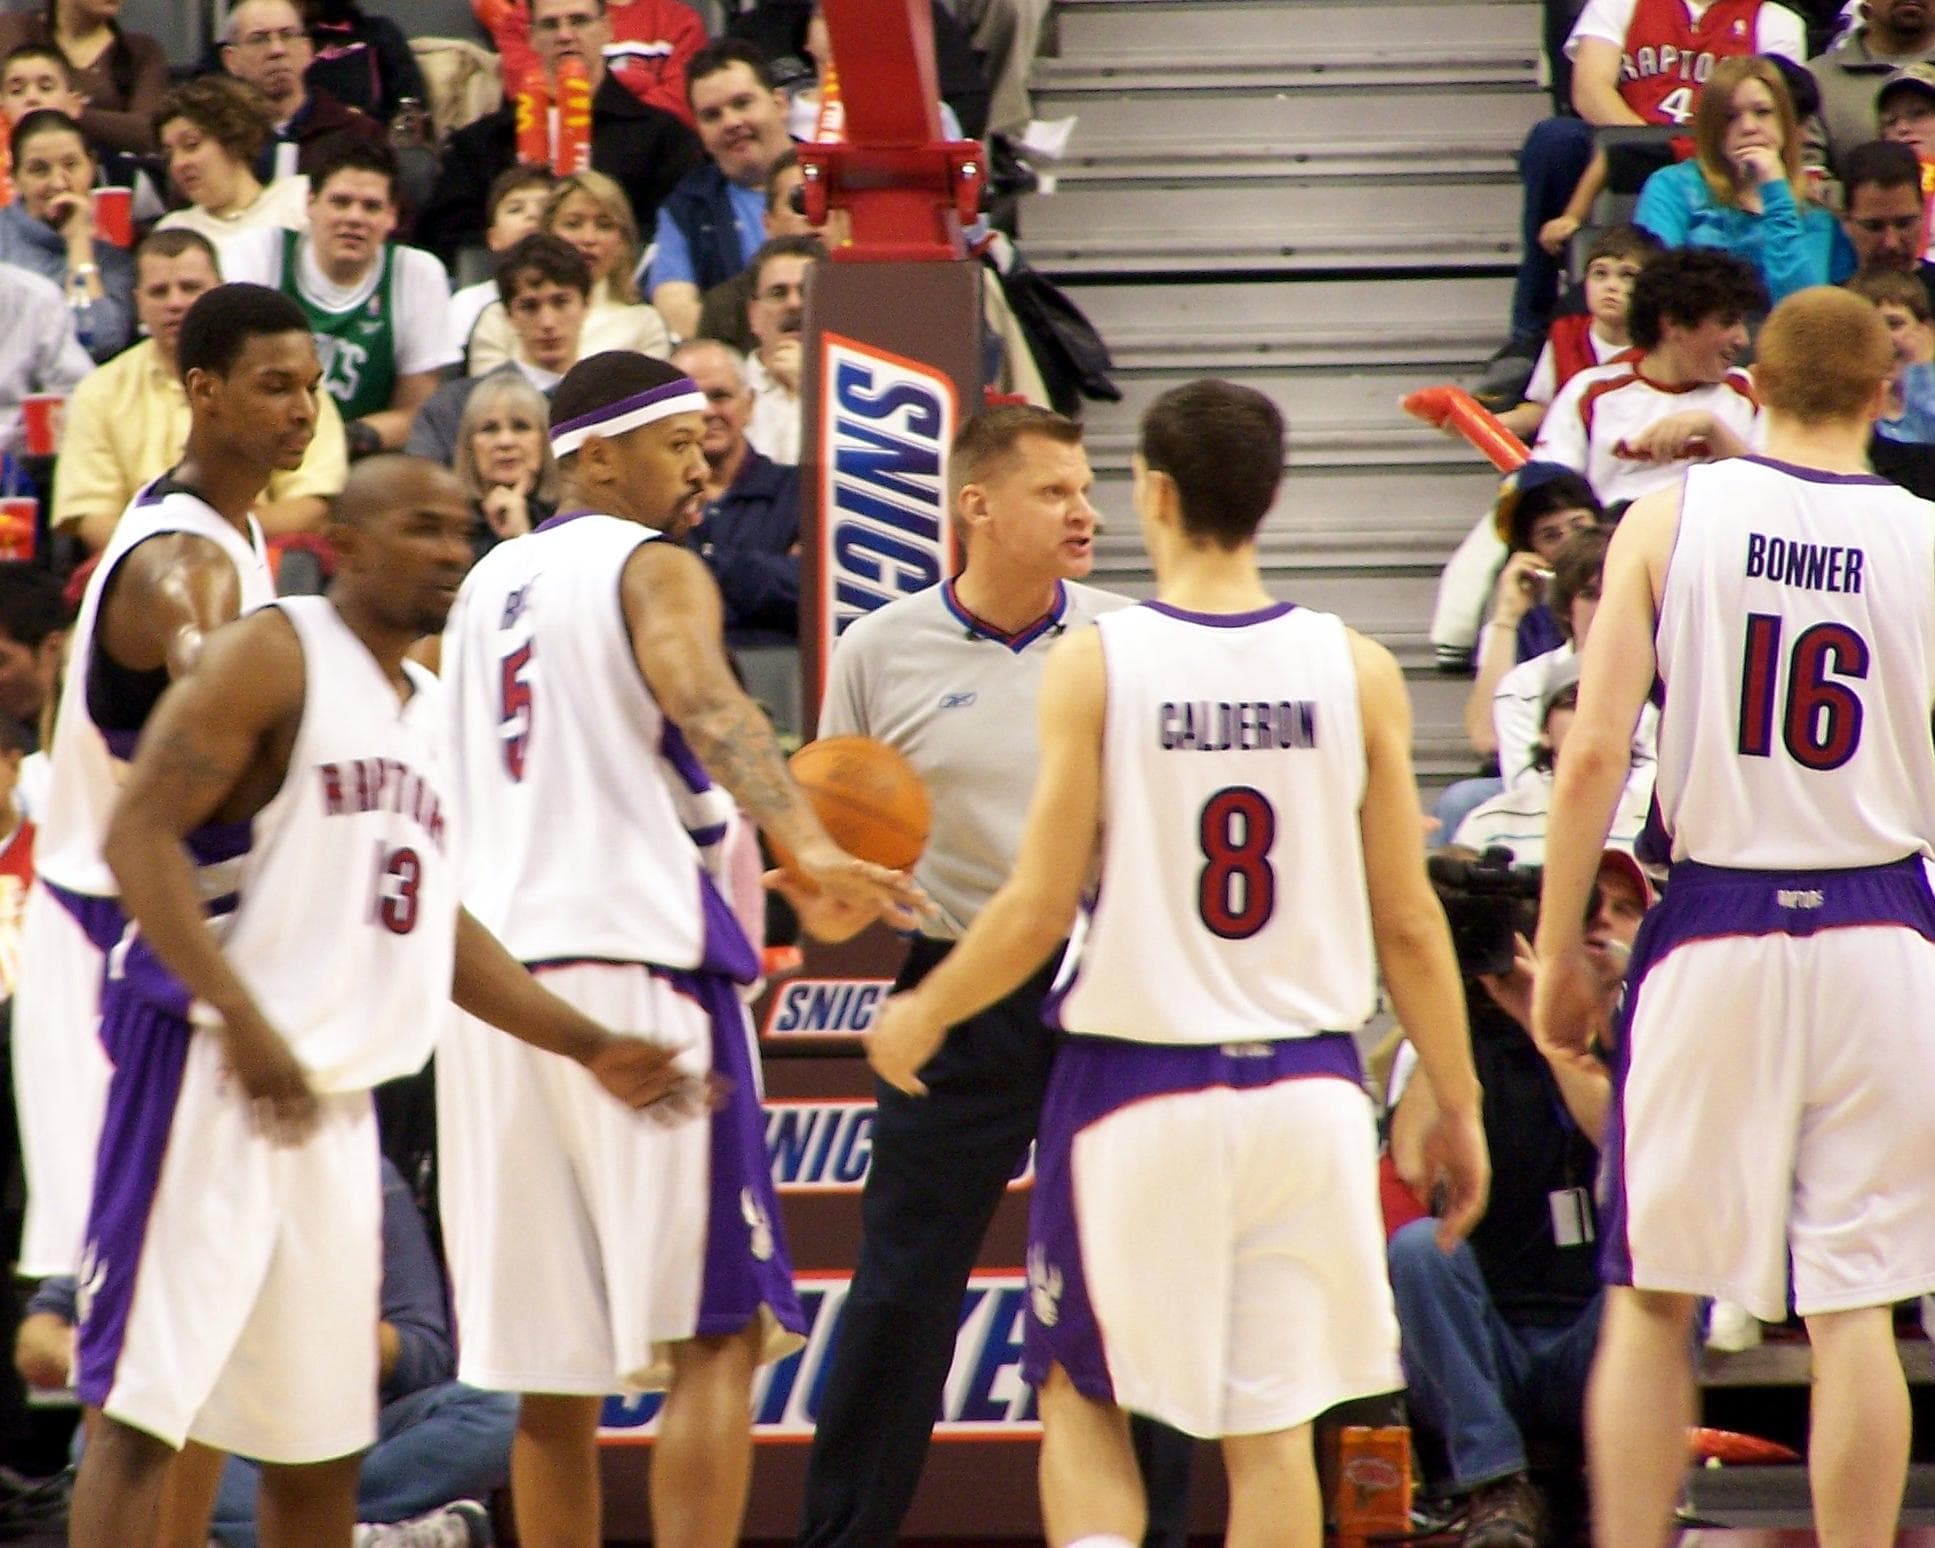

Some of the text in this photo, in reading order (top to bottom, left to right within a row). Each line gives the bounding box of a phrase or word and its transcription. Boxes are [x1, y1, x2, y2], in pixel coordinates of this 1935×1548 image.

[1619, 44, 1716, 83] RAPTO
[1658, 86, 1694, 123] 4
[1746, 532, 1864, 594] BONNER
[1738, 612, 1870, 771] 16
[1160, 700, 1317, 750] CALDERON
[1200, 786, 1274, 940] 8
[777, 984, 884, 1031] SNIC
[766, 1110, 877, 1183] NIC
